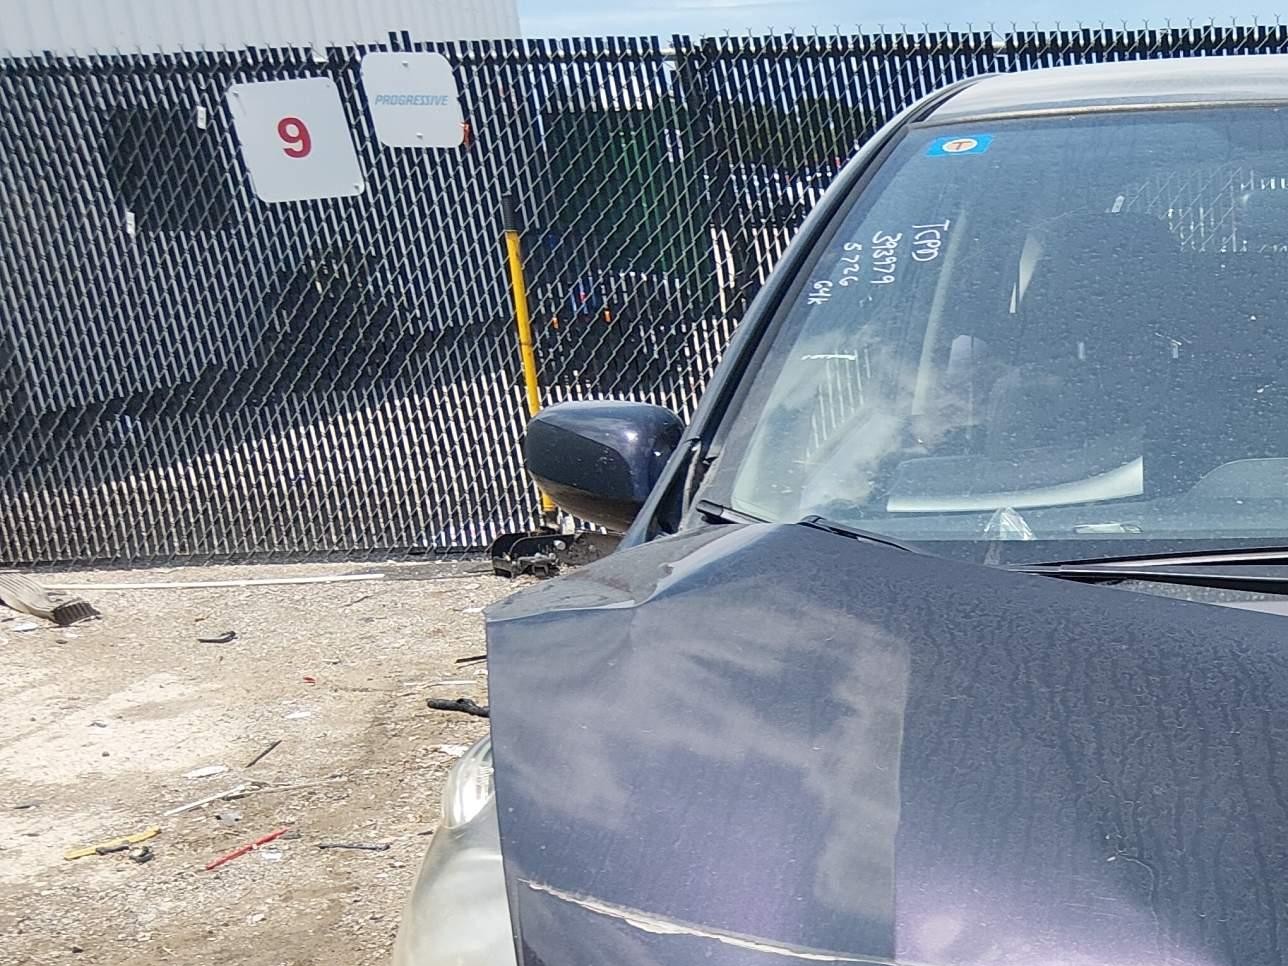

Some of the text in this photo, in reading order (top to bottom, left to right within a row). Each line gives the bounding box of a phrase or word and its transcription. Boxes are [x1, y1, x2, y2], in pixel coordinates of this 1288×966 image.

[374, 94, 449, 106] PROGRESSIVE
[277, 116, 312, 158] 9
[870, 230, 903, 285] 393979
[911, 219, 951, 262] TCPD
